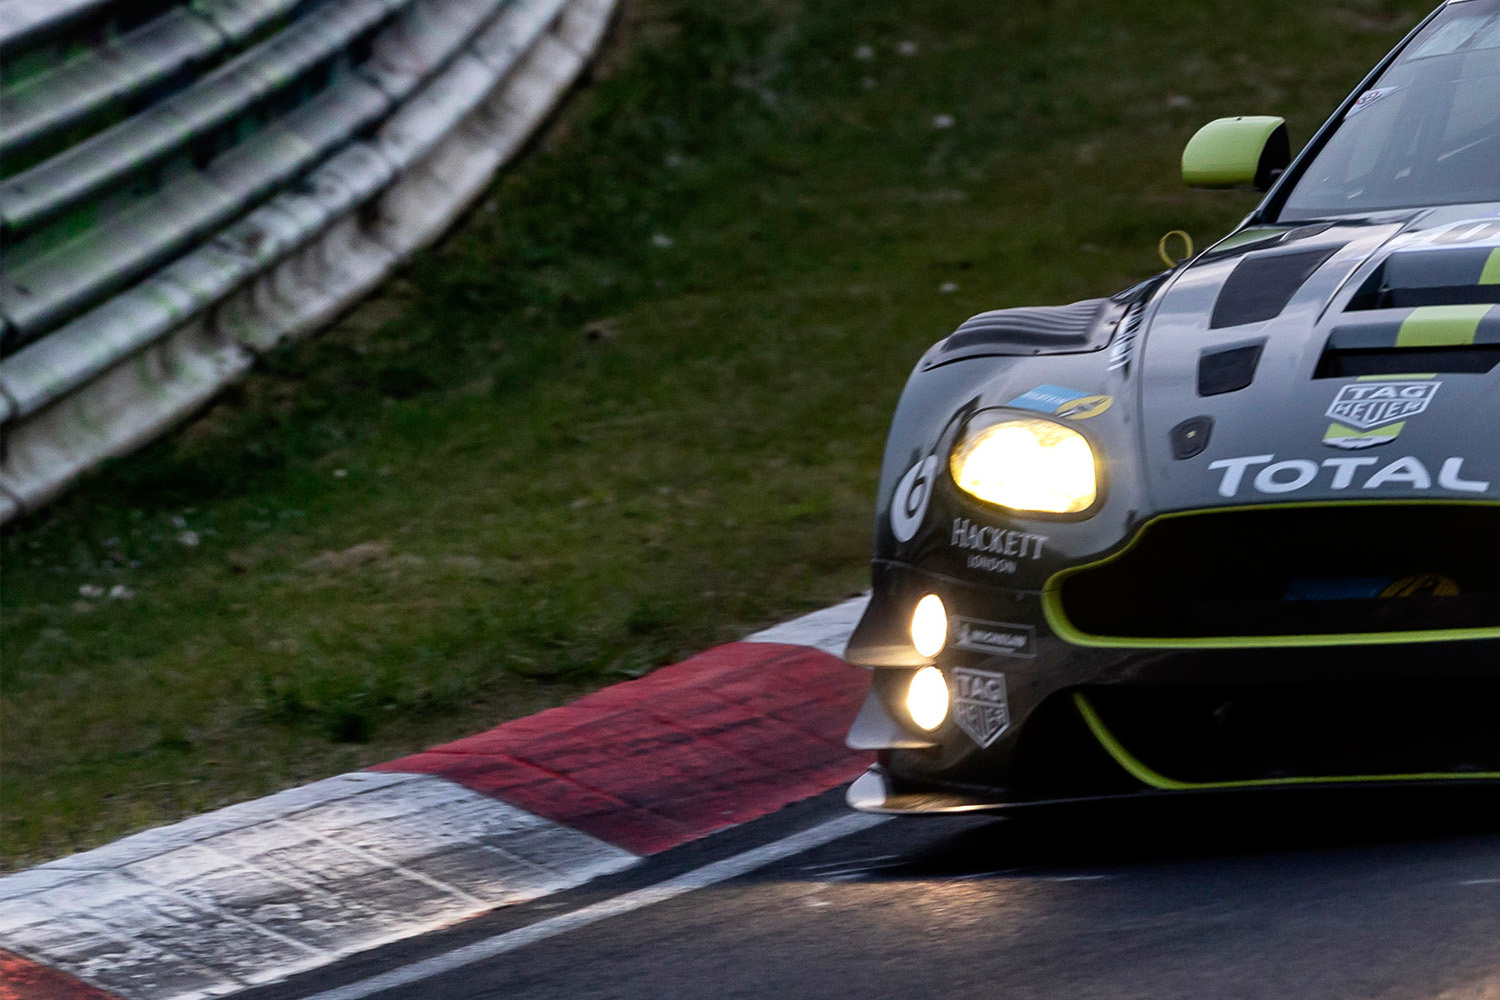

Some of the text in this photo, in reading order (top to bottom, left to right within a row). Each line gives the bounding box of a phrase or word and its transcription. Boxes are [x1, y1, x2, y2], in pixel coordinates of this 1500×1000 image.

[1348, 385, 1428, 400] TAG
[1333, 401, 1423, 423] HEUER
[1207, 453, 1490, 498] TOTAL
[951, 517, 1049, 560] HACKETT
[957, 674, 1000, 700] TAG
